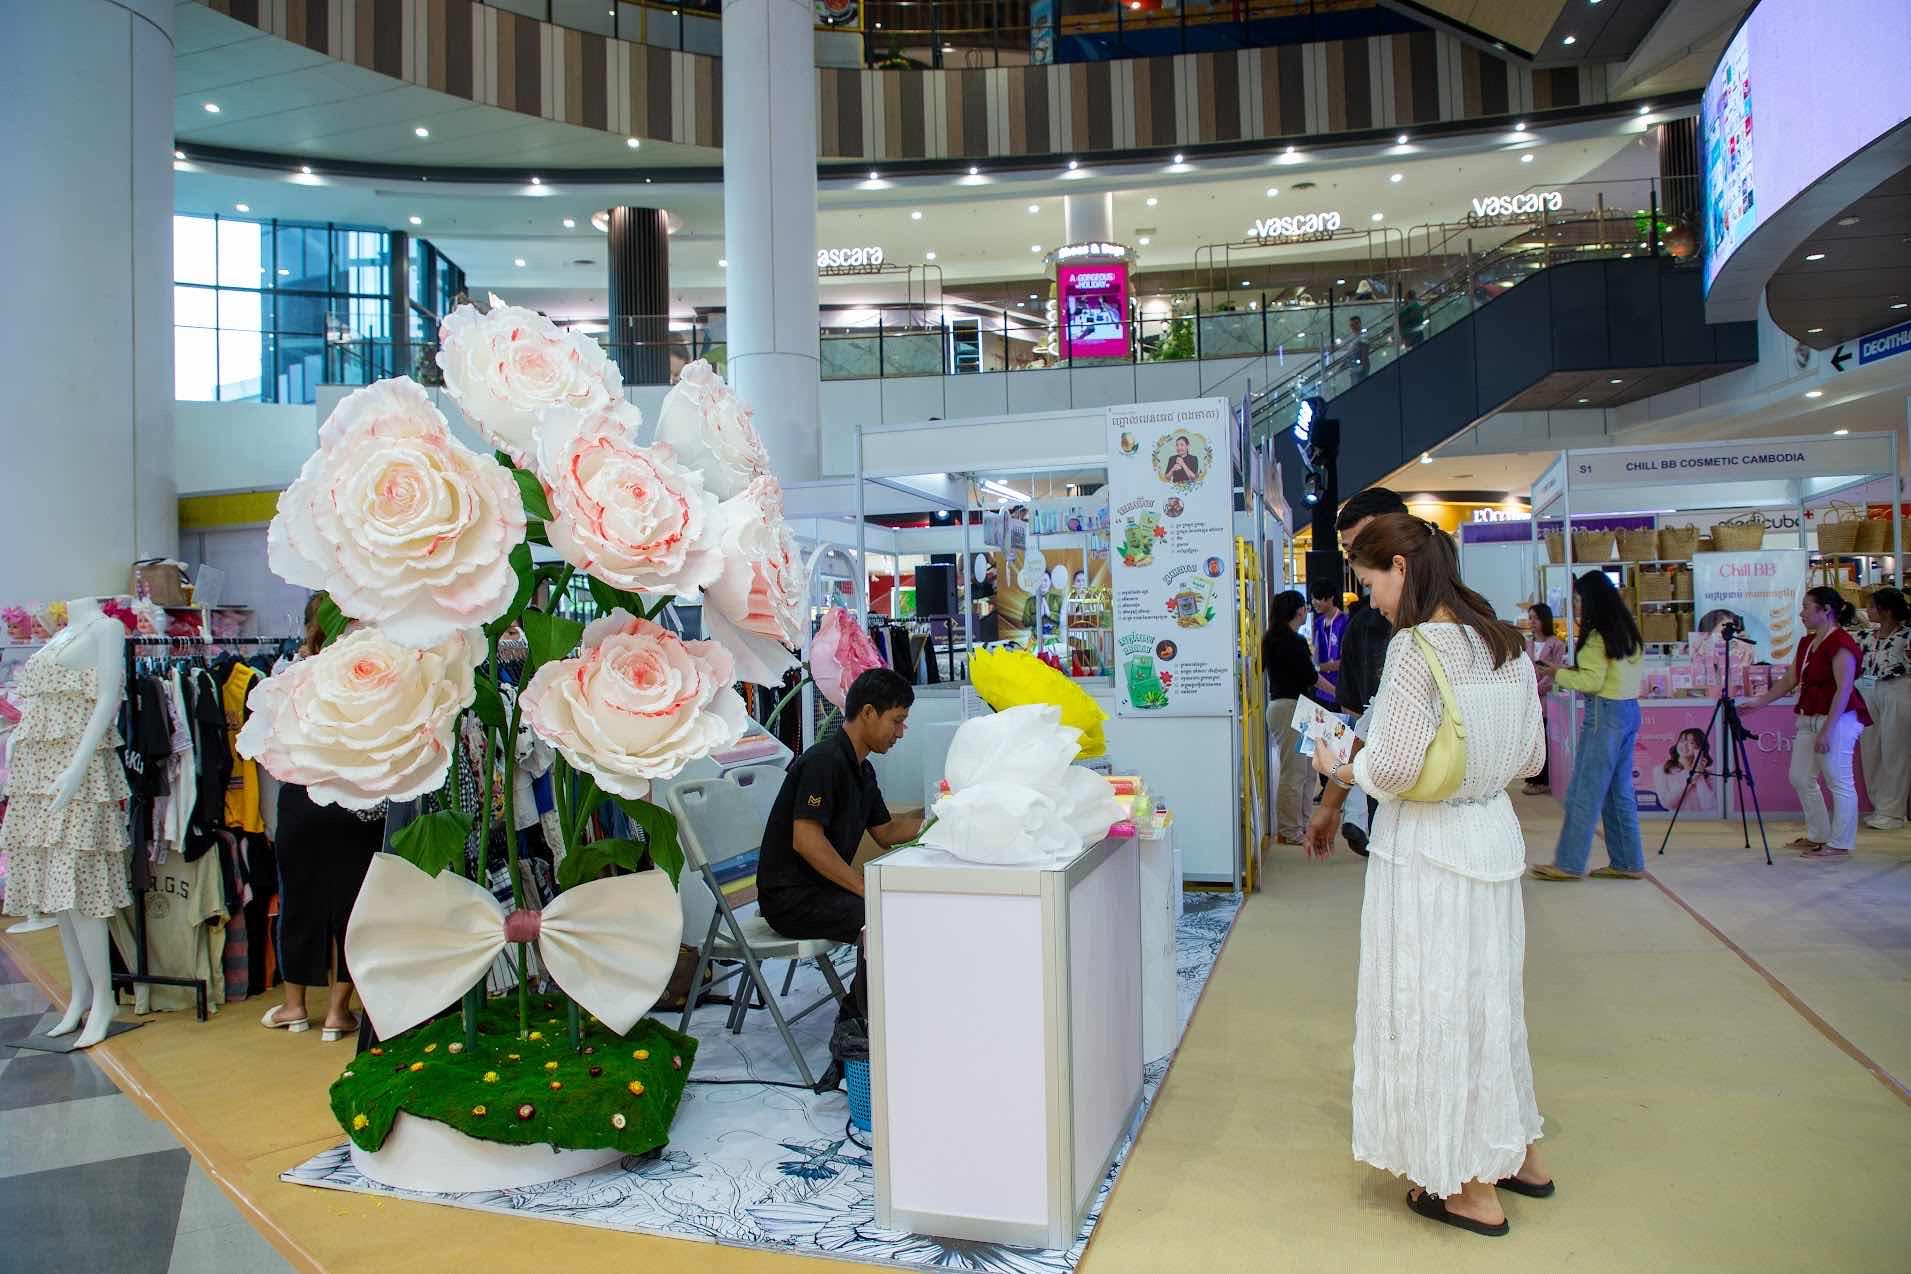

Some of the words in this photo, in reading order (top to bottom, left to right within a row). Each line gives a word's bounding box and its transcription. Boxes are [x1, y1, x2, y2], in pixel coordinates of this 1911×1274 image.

[1472, 191, 1562, 217] vascara
[1256, 211, 1341, 237] vascara
[816, 246, 883, 268] ascara
[1579, 465, 1592, 474] S1
[1625, 460, 1658, 472] CHILL
[1660, 460, 1678, 469] BB
[1680, 456, 1739, 469] COSMETIC
[1742, 452, 1806, 465] CAMBODIA
